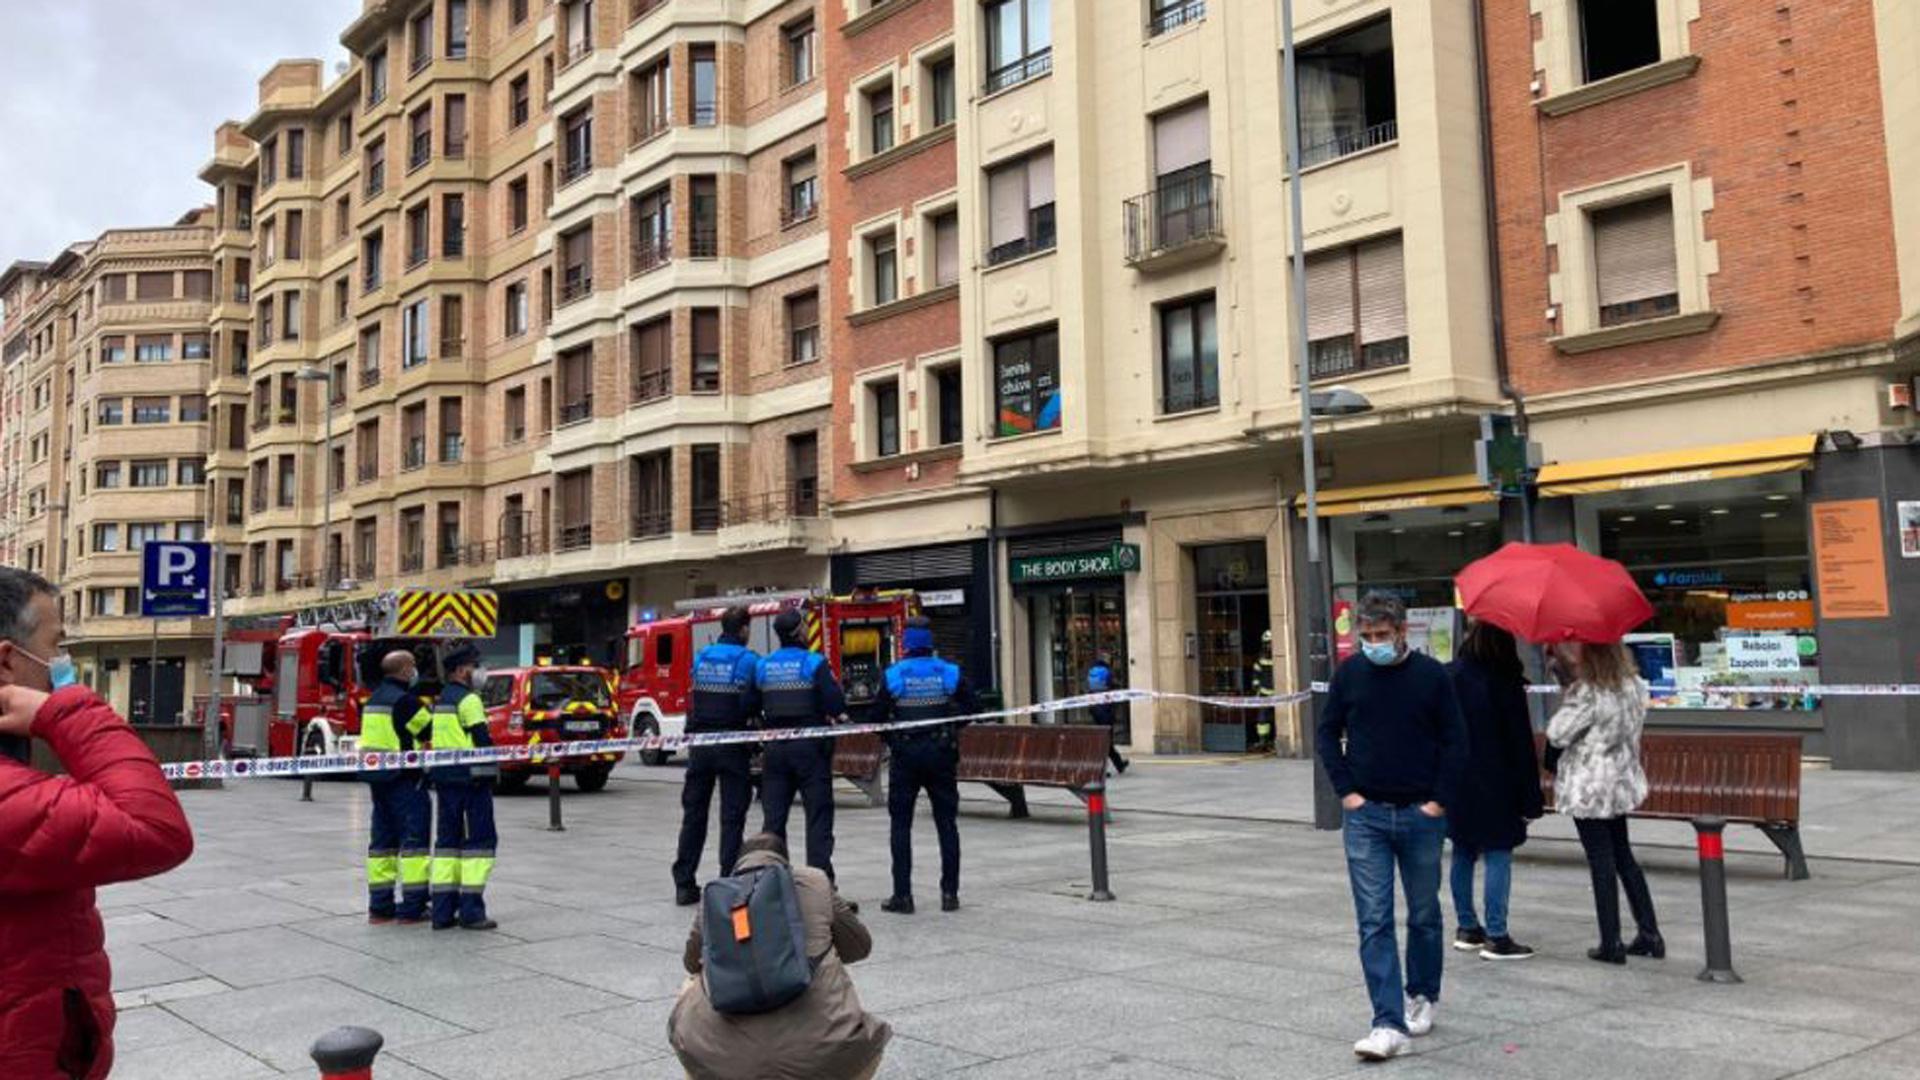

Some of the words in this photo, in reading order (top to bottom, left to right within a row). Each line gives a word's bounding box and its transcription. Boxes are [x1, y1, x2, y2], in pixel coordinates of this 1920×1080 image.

[158, 546, 196, 586] P
[1021, 564, 1043, 578] THE
[1045, 560, 1076, 576] BODY
